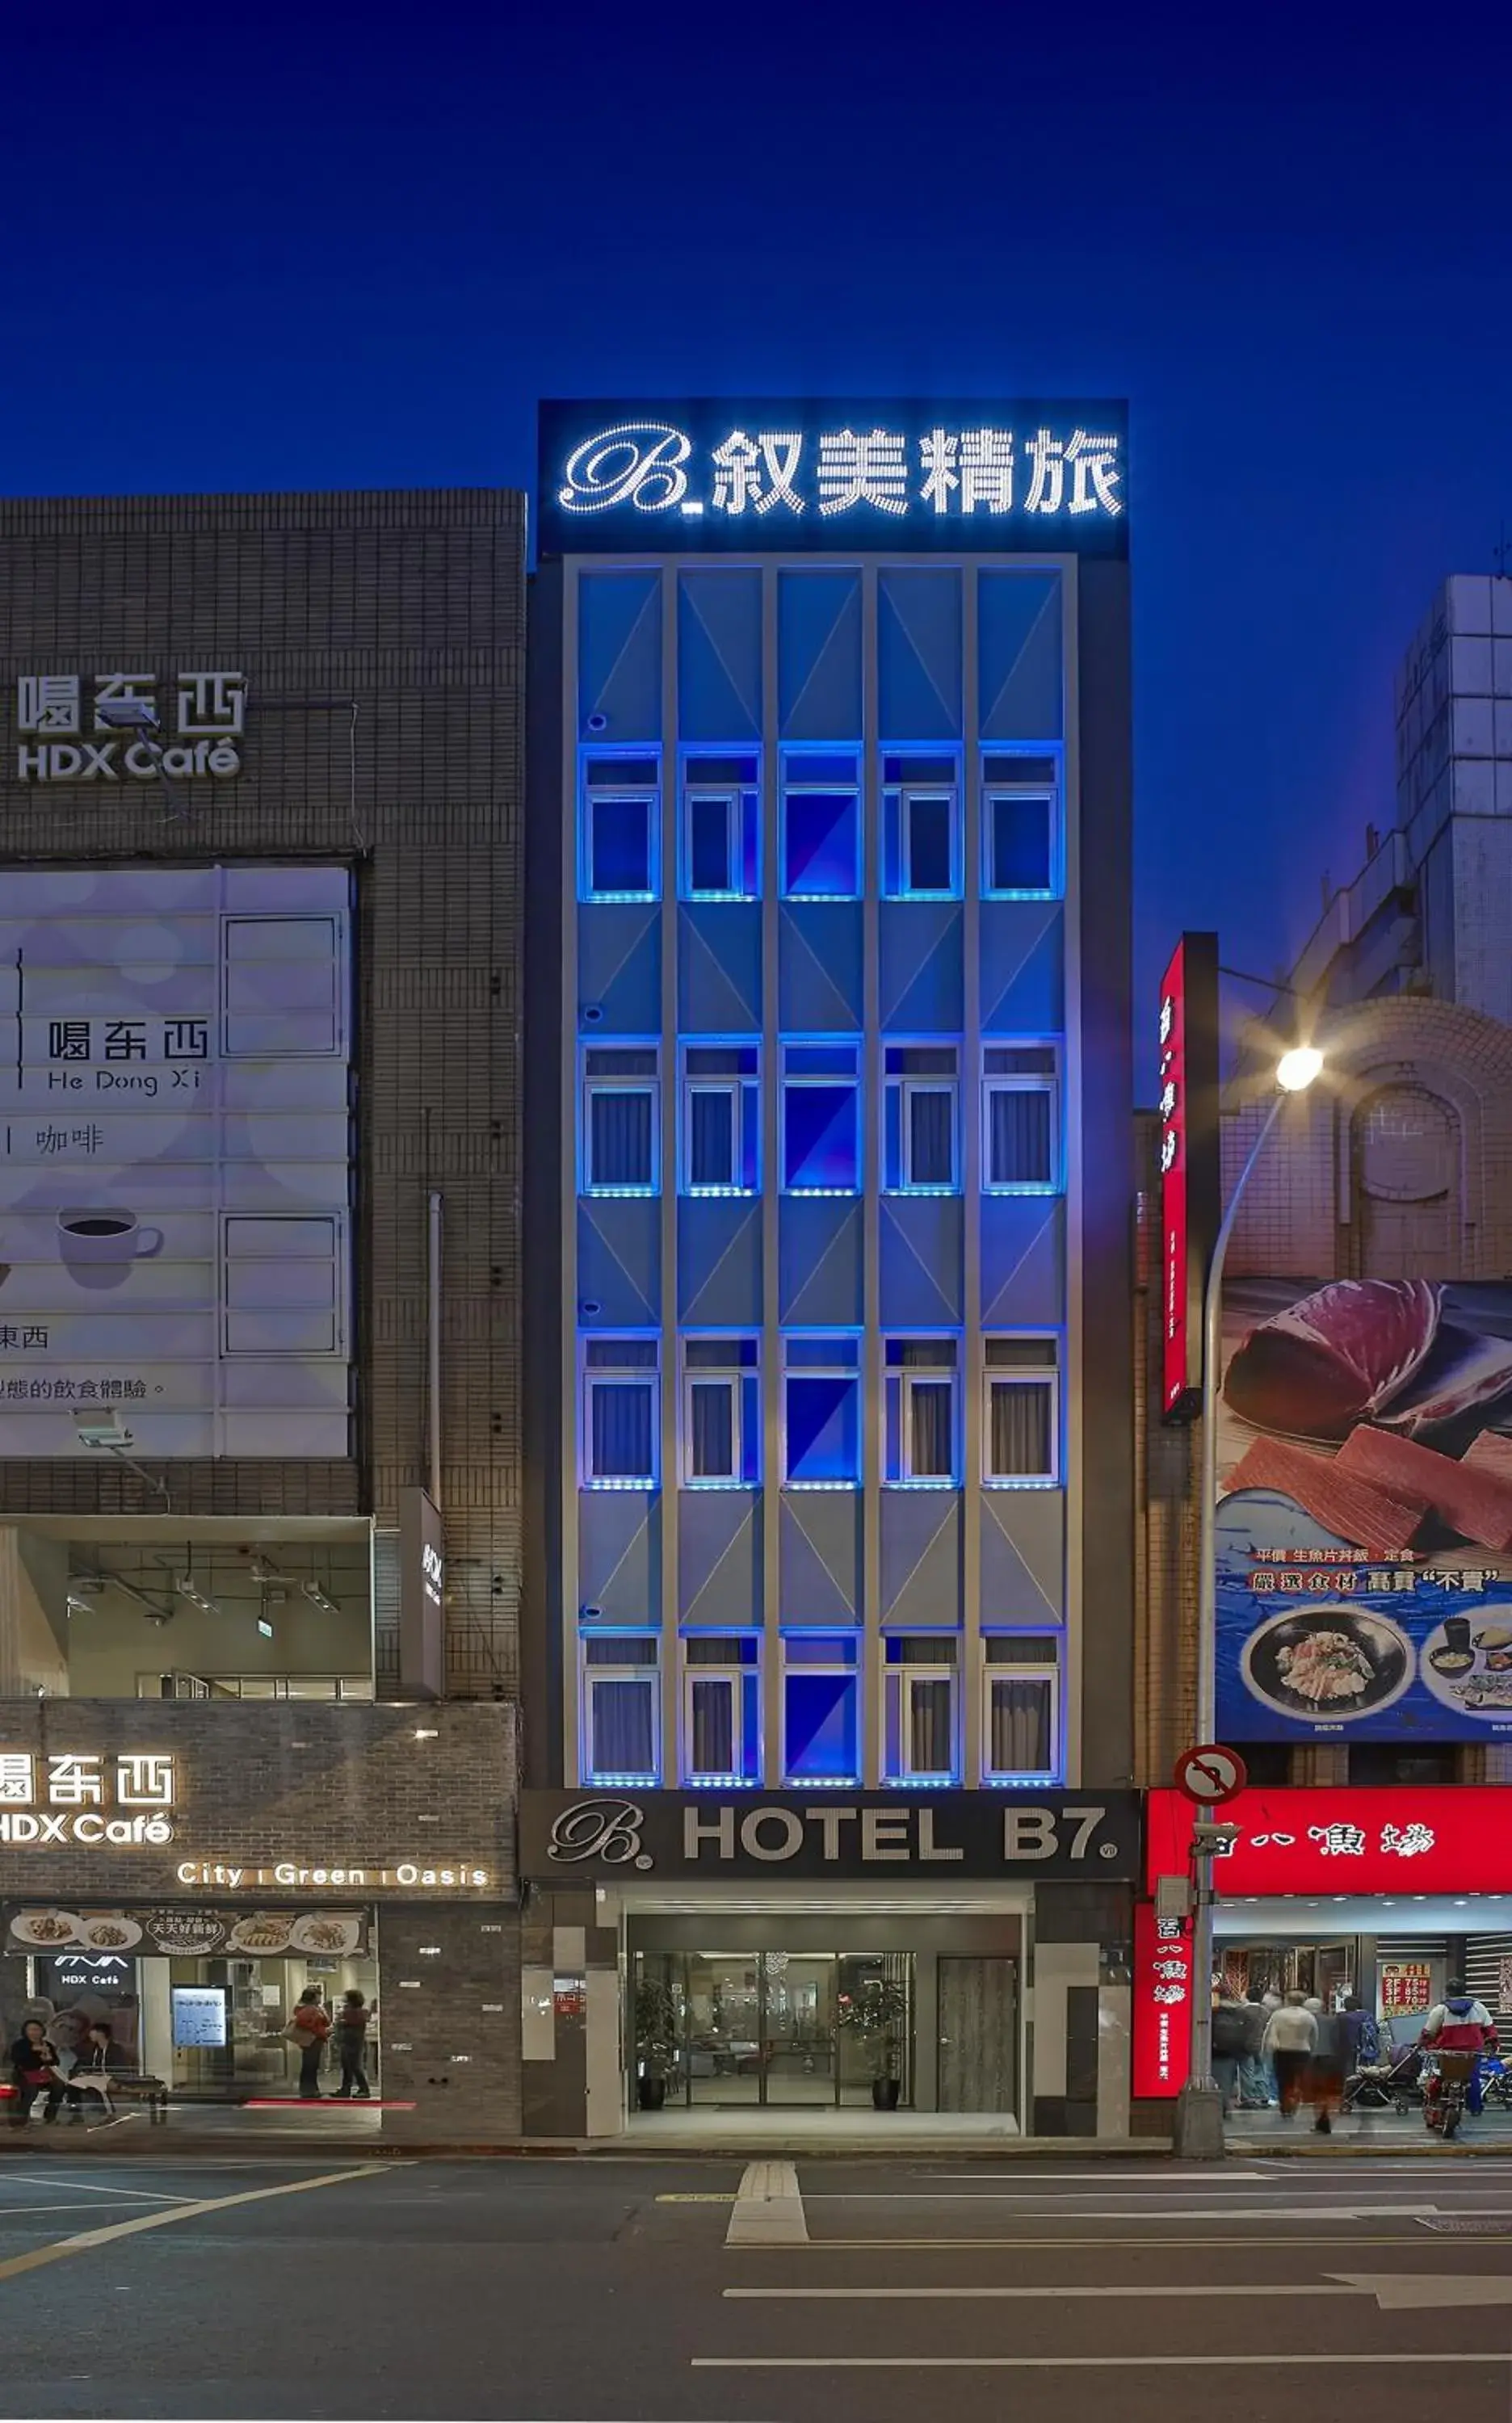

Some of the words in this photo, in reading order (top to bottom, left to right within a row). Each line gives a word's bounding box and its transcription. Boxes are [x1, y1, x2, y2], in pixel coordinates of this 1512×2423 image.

[712, 428, 1122, 515] 叙美精旅
[19, 742, 118, 781] HDX
[124, 737, 241, 780] Café
[48, 1072, 83, 1090] He
[96, 1071, 158, 1097] Dong
[172, 1070, 200, 1088] Xi
[36, 1124, 103, 1154] 咖啡
[0, 1379, 165, 1400] 態的飲食體驗。
[73, 1812, 174, 1844] Café
[684, 1807, 964, 1861] HOTEL
[1004, 1807, 1106, 1860] B7
[177, 1862, 242, 1888] City
[275, 1862, 365, 1885] Green
[396, 1863, 488, 1886] Oasis
[61, 1976, 87, 1984] HDX
